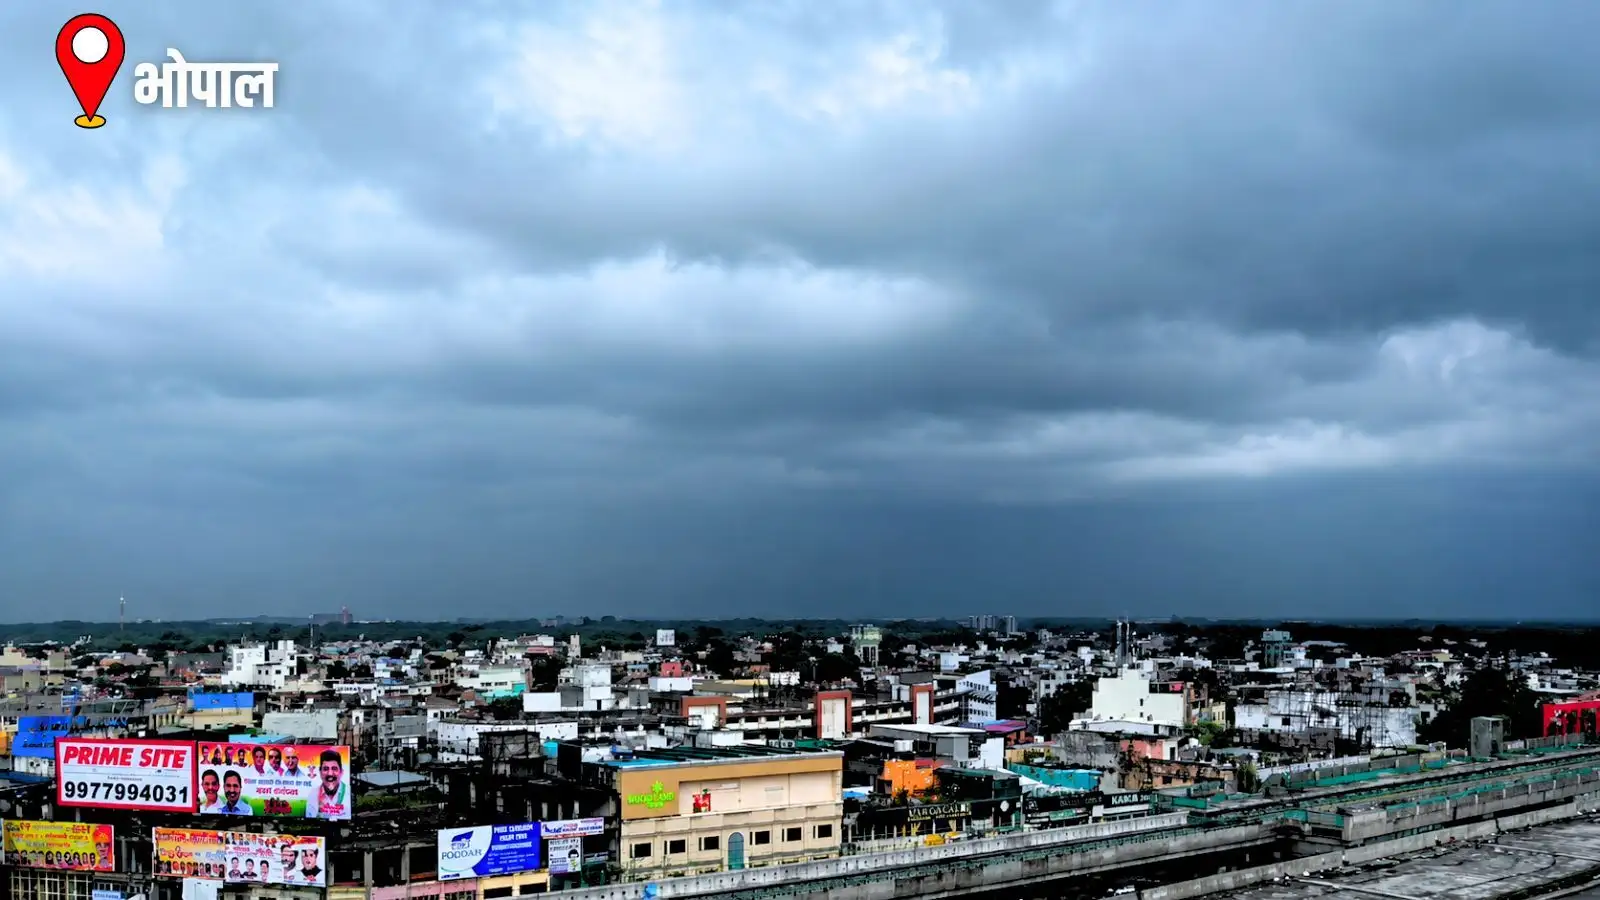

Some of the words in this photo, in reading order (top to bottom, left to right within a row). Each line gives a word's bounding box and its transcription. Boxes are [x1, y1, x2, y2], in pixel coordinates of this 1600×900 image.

[63, 746, 134, 767] PRIME
[138, 748, 188, 769] SITE
[64, 781, 188, 803] 9977994031
